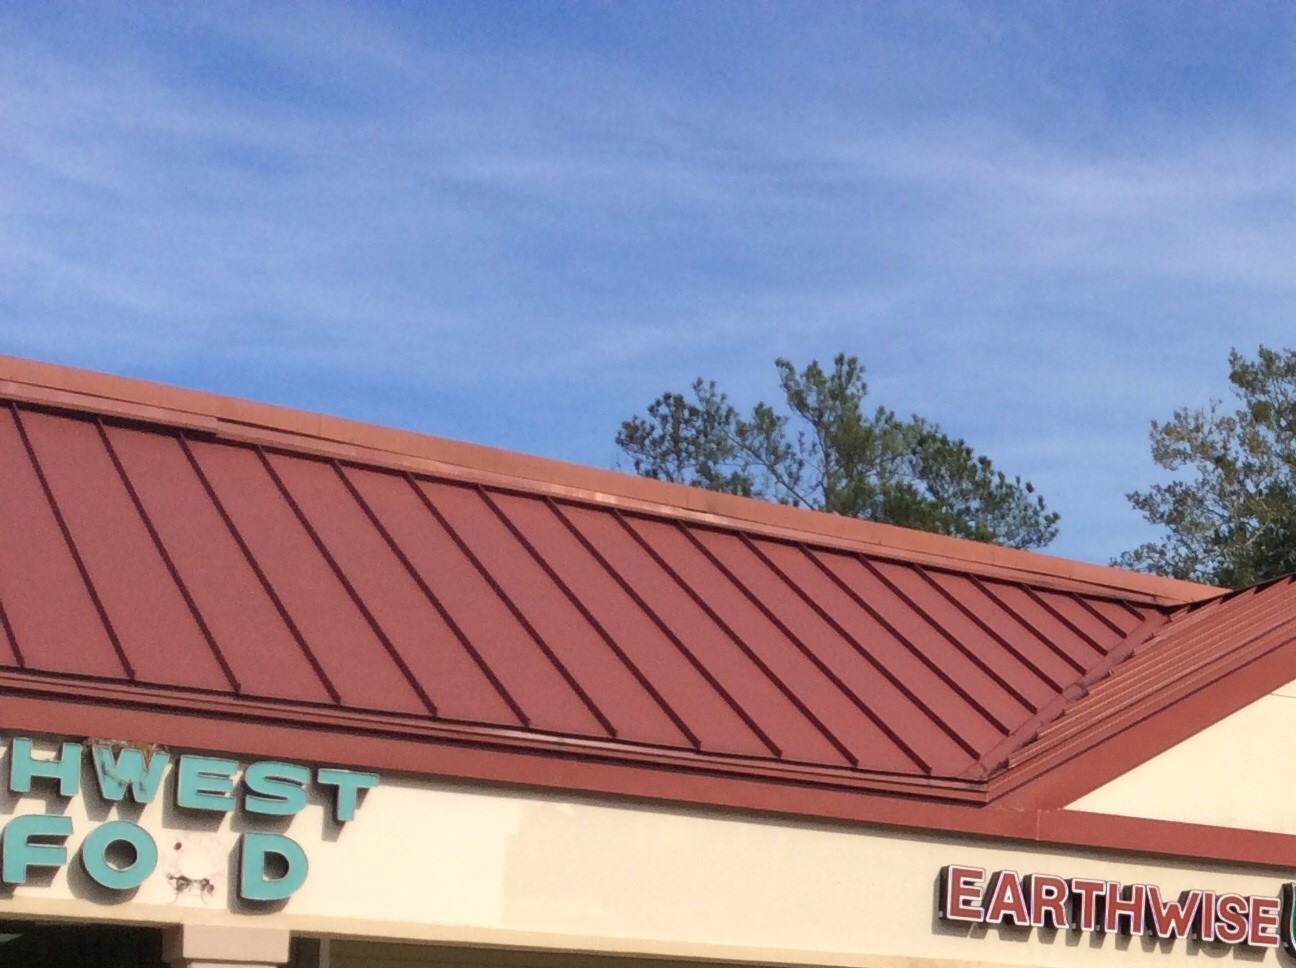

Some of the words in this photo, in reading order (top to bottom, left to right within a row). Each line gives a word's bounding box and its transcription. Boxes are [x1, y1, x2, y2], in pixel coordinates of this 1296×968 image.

[0, 736, 379, 823] HWEST
[1, 814, 309, 902] FOD
[945, 864, 1281, 948] EARTHWISE
